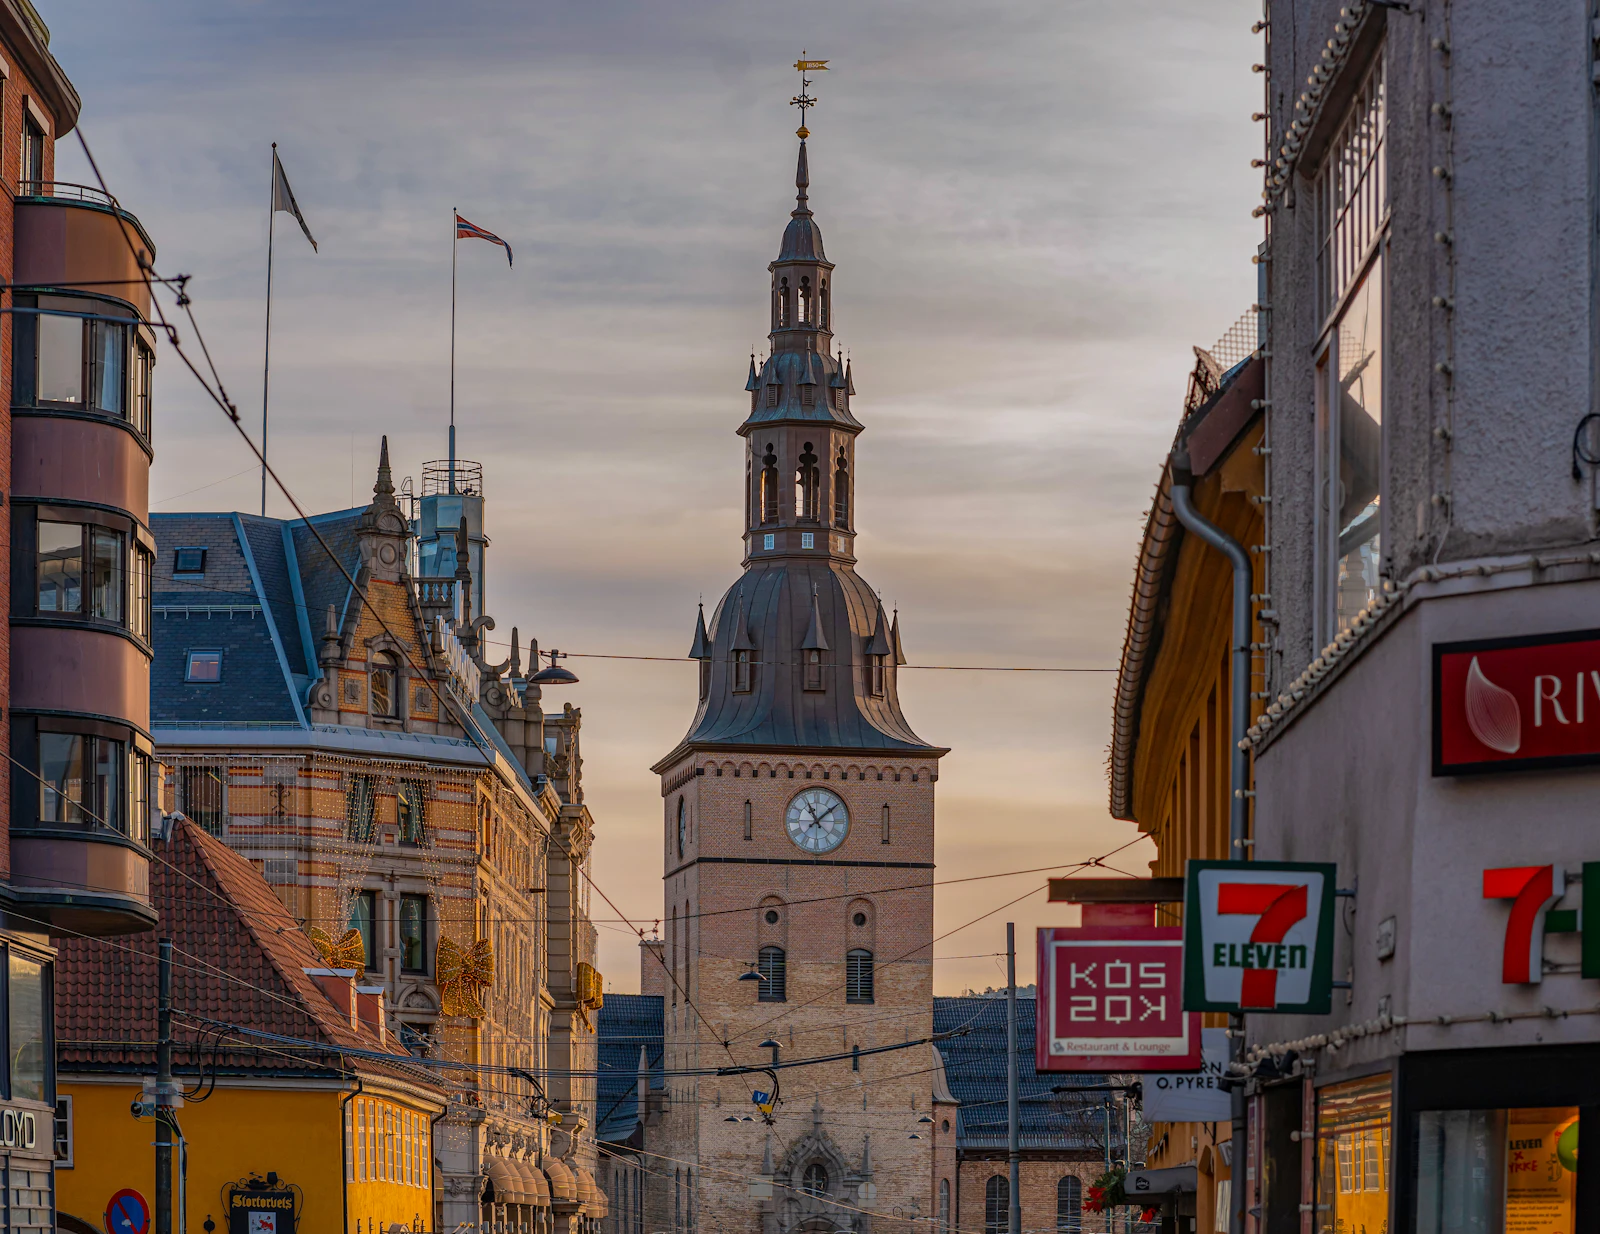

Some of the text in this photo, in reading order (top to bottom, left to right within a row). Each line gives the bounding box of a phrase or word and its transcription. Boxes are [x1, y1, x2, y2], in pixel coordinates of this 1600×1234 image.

[1534, 670, 1600, 728] RI
[1217, 883, 1308, 1008] 7
[1066, 1041, 1171, 1054] Restaurant & Lounge
[0, 1109, 36, 1149] OYD
